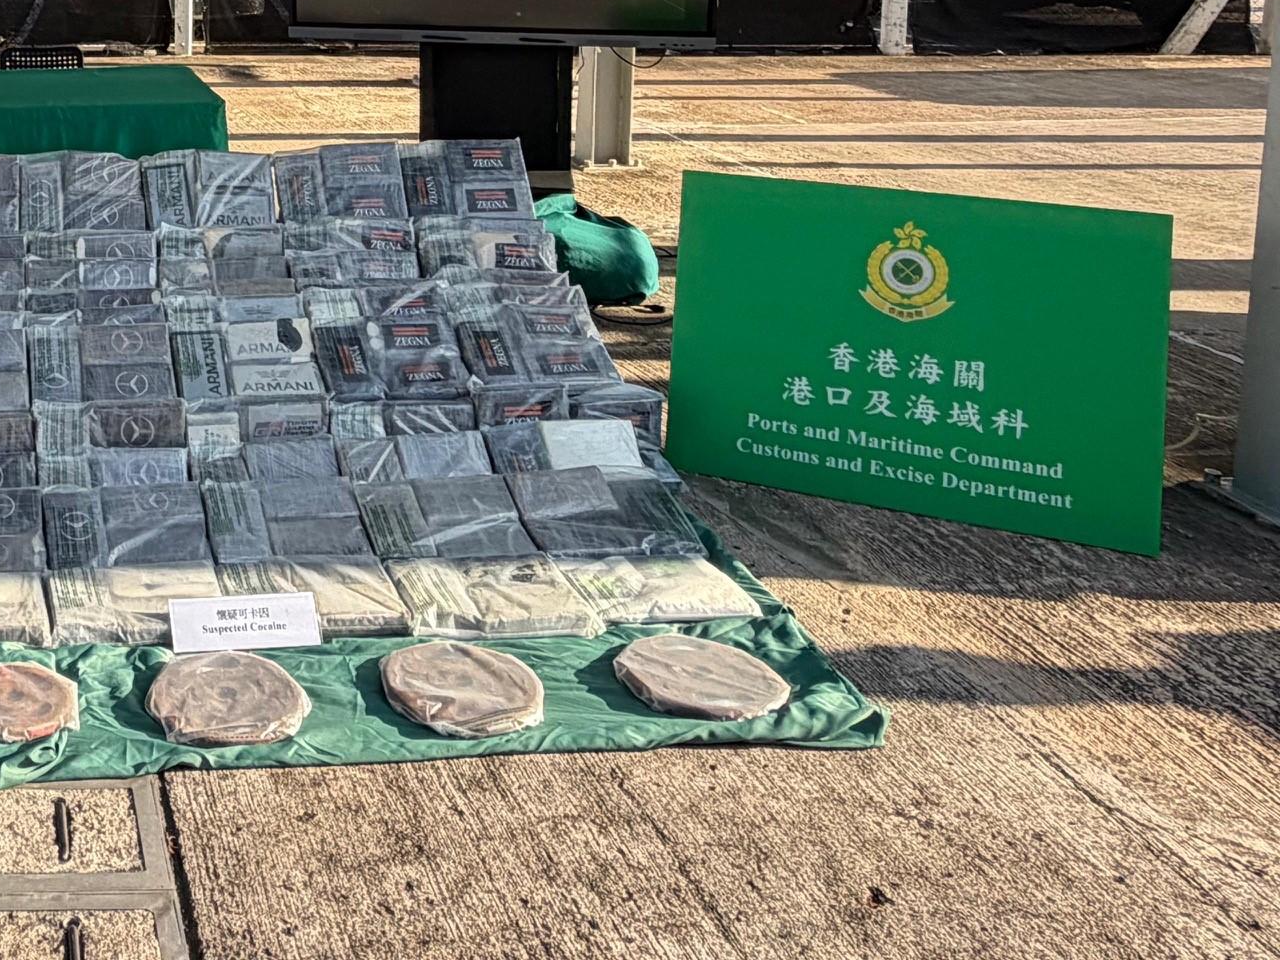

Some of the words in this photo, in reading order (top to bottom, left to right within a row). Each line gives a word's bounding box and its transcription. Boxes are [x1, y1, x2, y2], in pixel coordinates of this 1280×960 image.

[475, 199, 509, 209] ZEGNA
[213, 214, 266, 227] RMANI
[394, 336, 431, 347] ZEGNA
[237, 342, 291, 356] ARMA
[200, 337, 223, 396] ARMANI
[827, 342, 985, 392] 香港海關
[241, 381, 316, 393] ARMANI
[782, 376, 1030, 440] 港口及海域科
[747, 412, 798, 436] Ports
[803, 425, 840, 443] and
[846, 428, 944, 460] Maritime
[950, 445, 1064, 480] Command
[736, 437, 820, 466] Customs
[825, 456, 862, 473] and
[869, 459, 935, 486] Excise
[941, 471, 1074, 510] Department
[202, 623, 248, 635] Suspected
[250, 621, 287, 632] Cocaine
